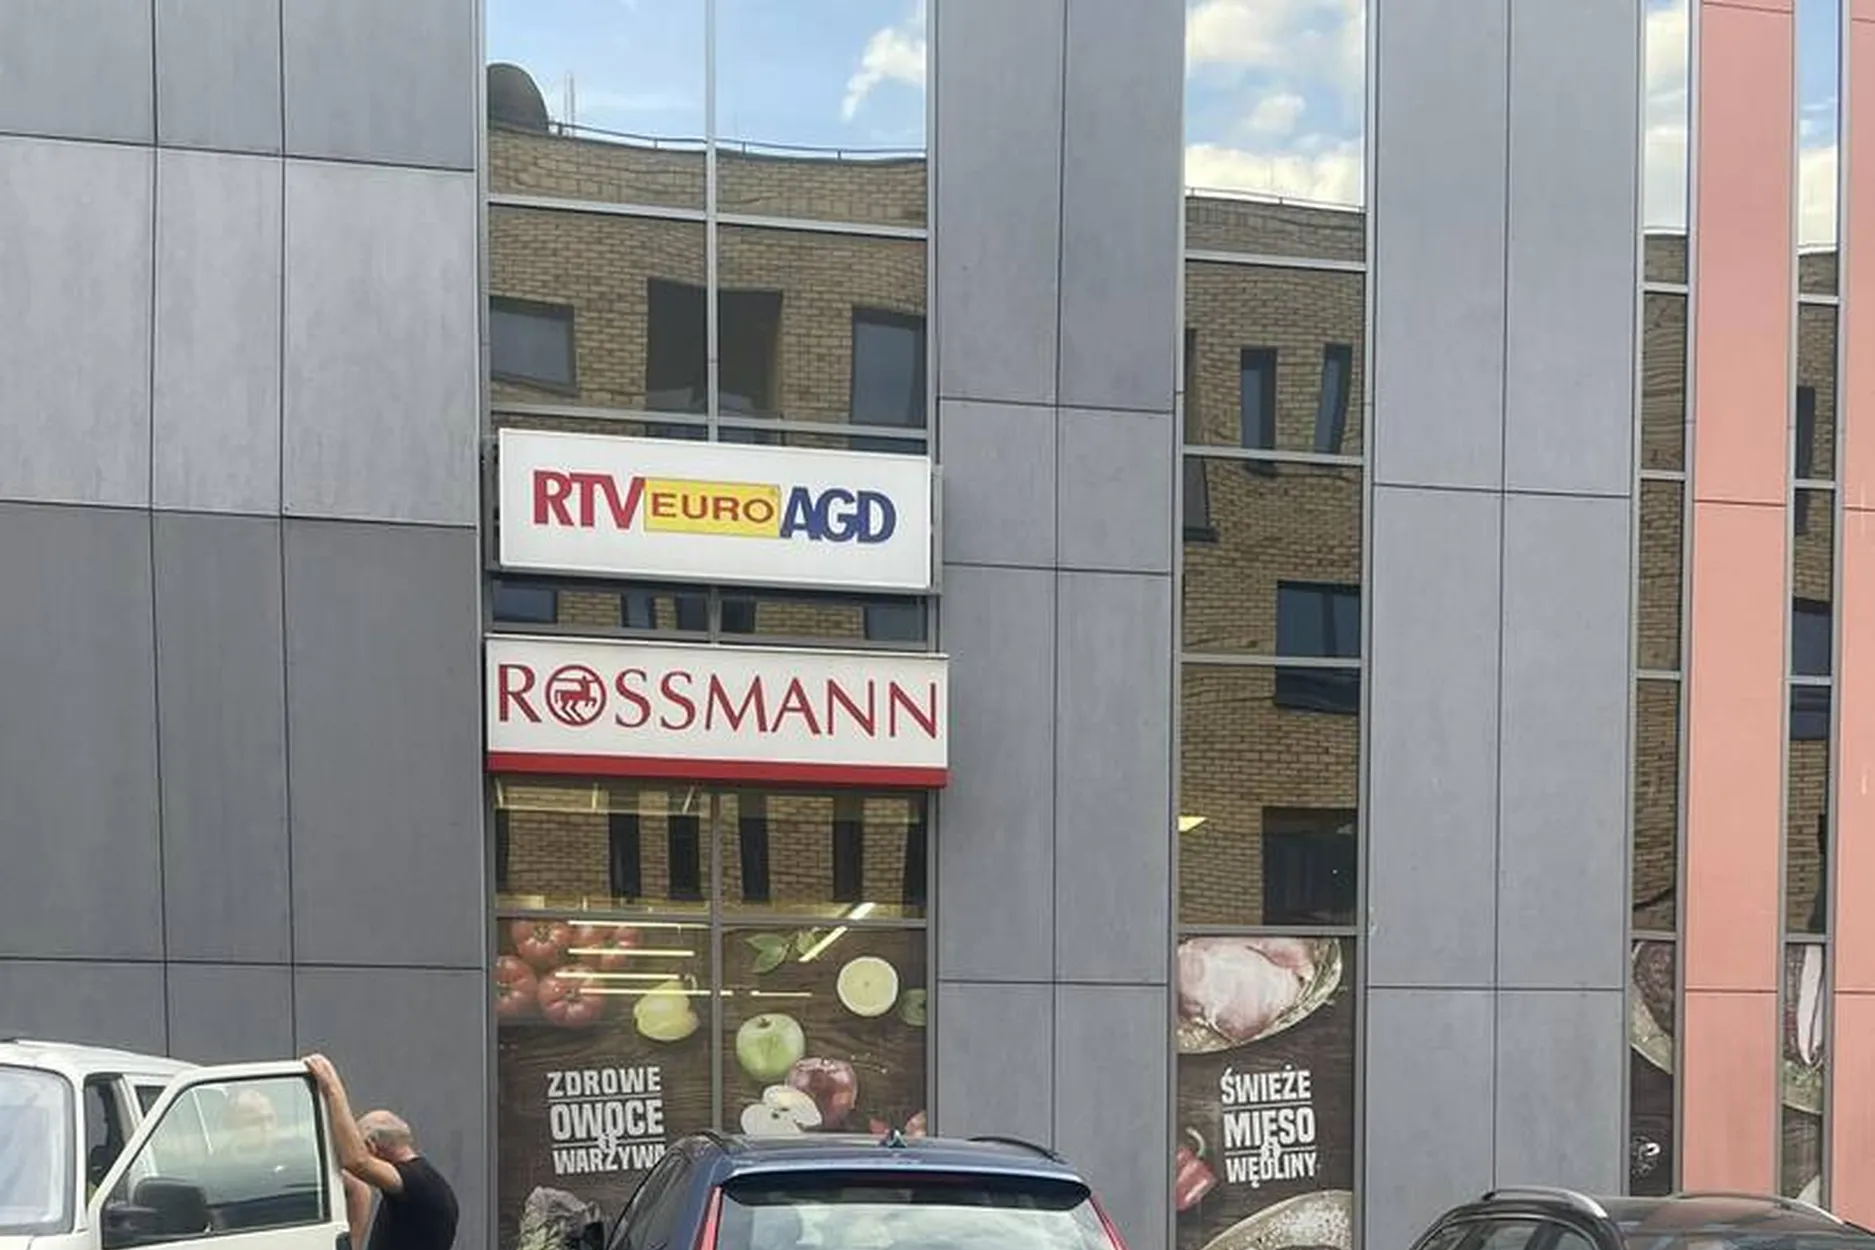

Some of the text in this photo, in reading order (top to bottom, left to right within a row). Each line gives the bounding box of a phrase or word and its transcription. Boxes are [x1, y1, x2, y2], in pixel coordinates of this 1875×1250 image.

[533, 470, 897, 544] RTV EURO AGD
[498, 664, 937, 739] ROSSMANN
[547, 1066, 661, 1097] ZDROWE
[1221, 1065, 1311, 1104] ŚWIEŻE
[550, 1100, 664, 1140] OWOCE
[1226, 1152, 1316, 1188] WĘDLINY
